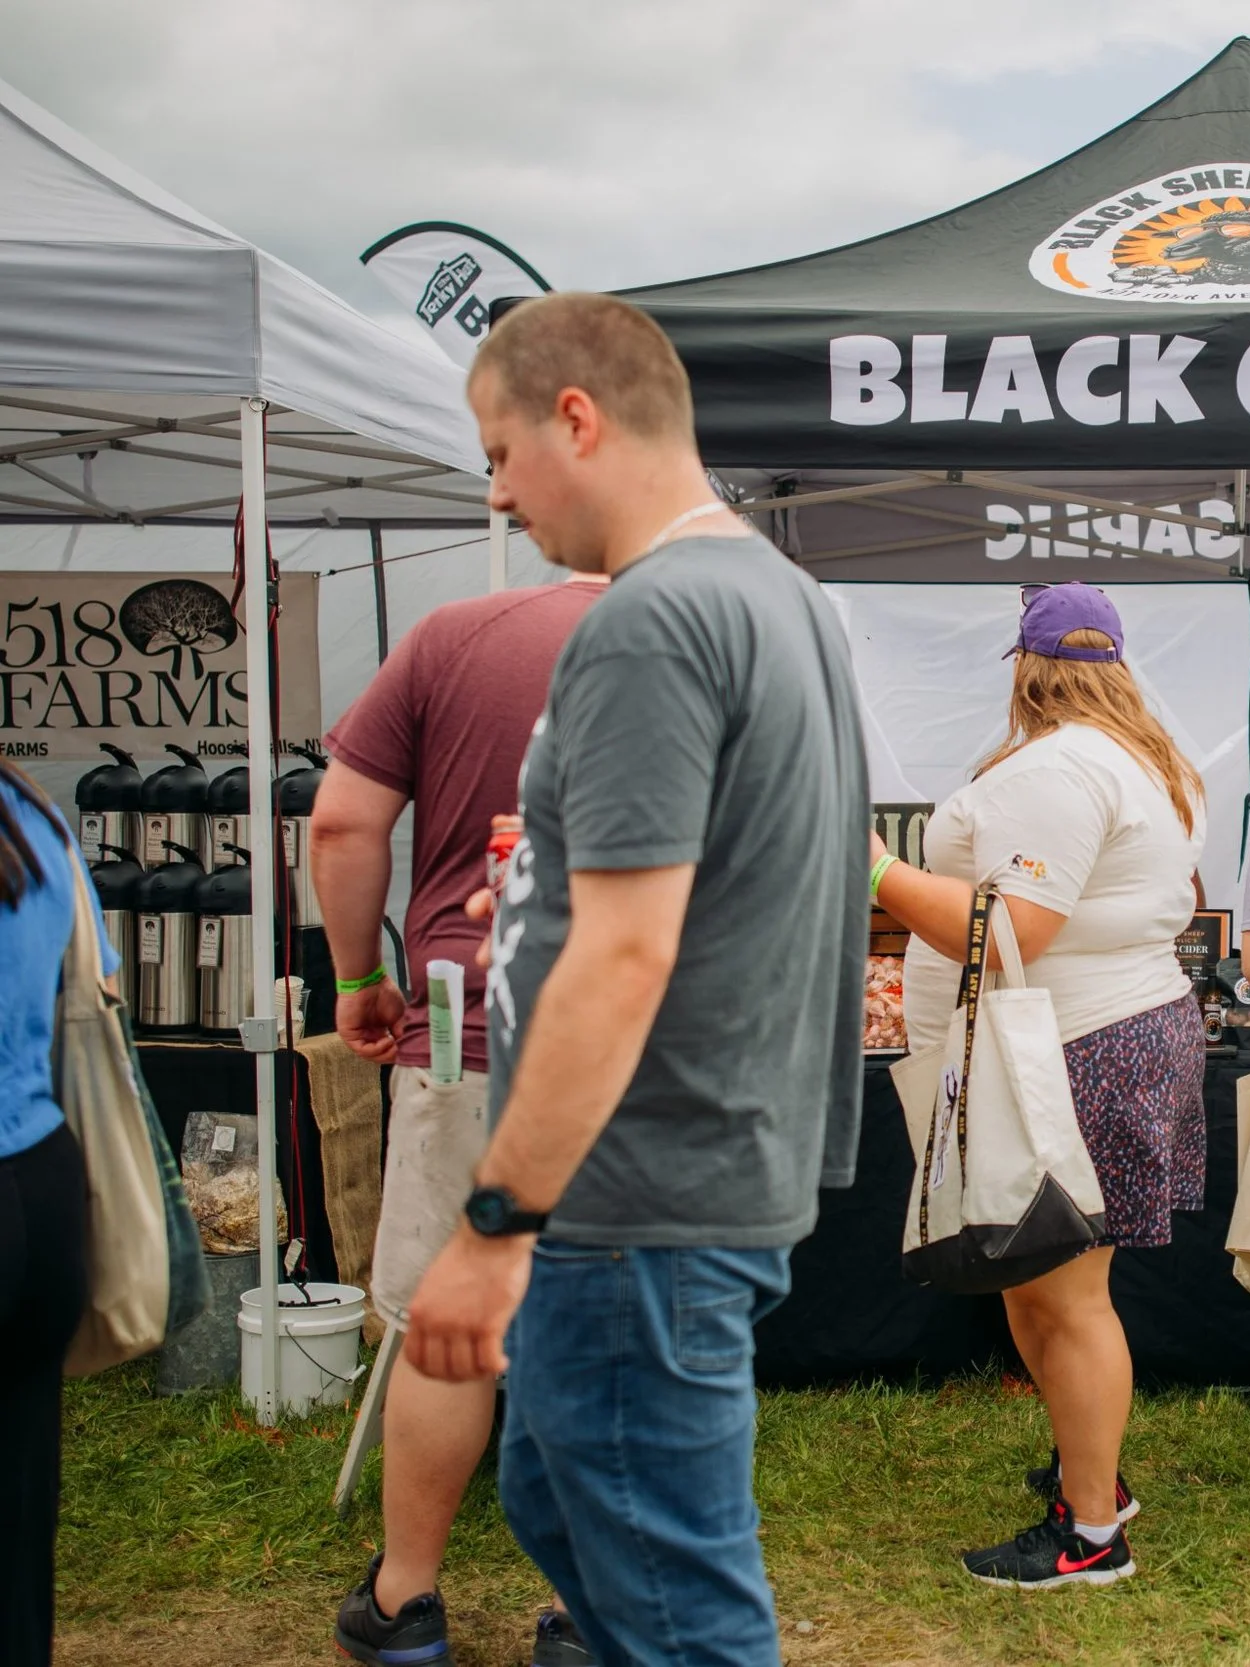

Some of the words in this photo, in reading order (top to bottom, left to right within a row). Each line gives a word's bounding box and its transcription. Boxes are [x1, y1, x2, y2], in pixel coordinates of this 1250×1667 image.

[1047, 190, 1162, 250] BLACK
[829, 334, 1208, 426] BLACK
[0, 596, 123, 668] 518
[0, 670, 249, 729] FARMS
[0, 741, 49, 757] FARMS
[972, 918, 985, 944] PAPI
[970, 947, 982, 965] BIG
[1178, 944, 1209, 954] CIDER
[969, 973, 980, 999] PAPI
